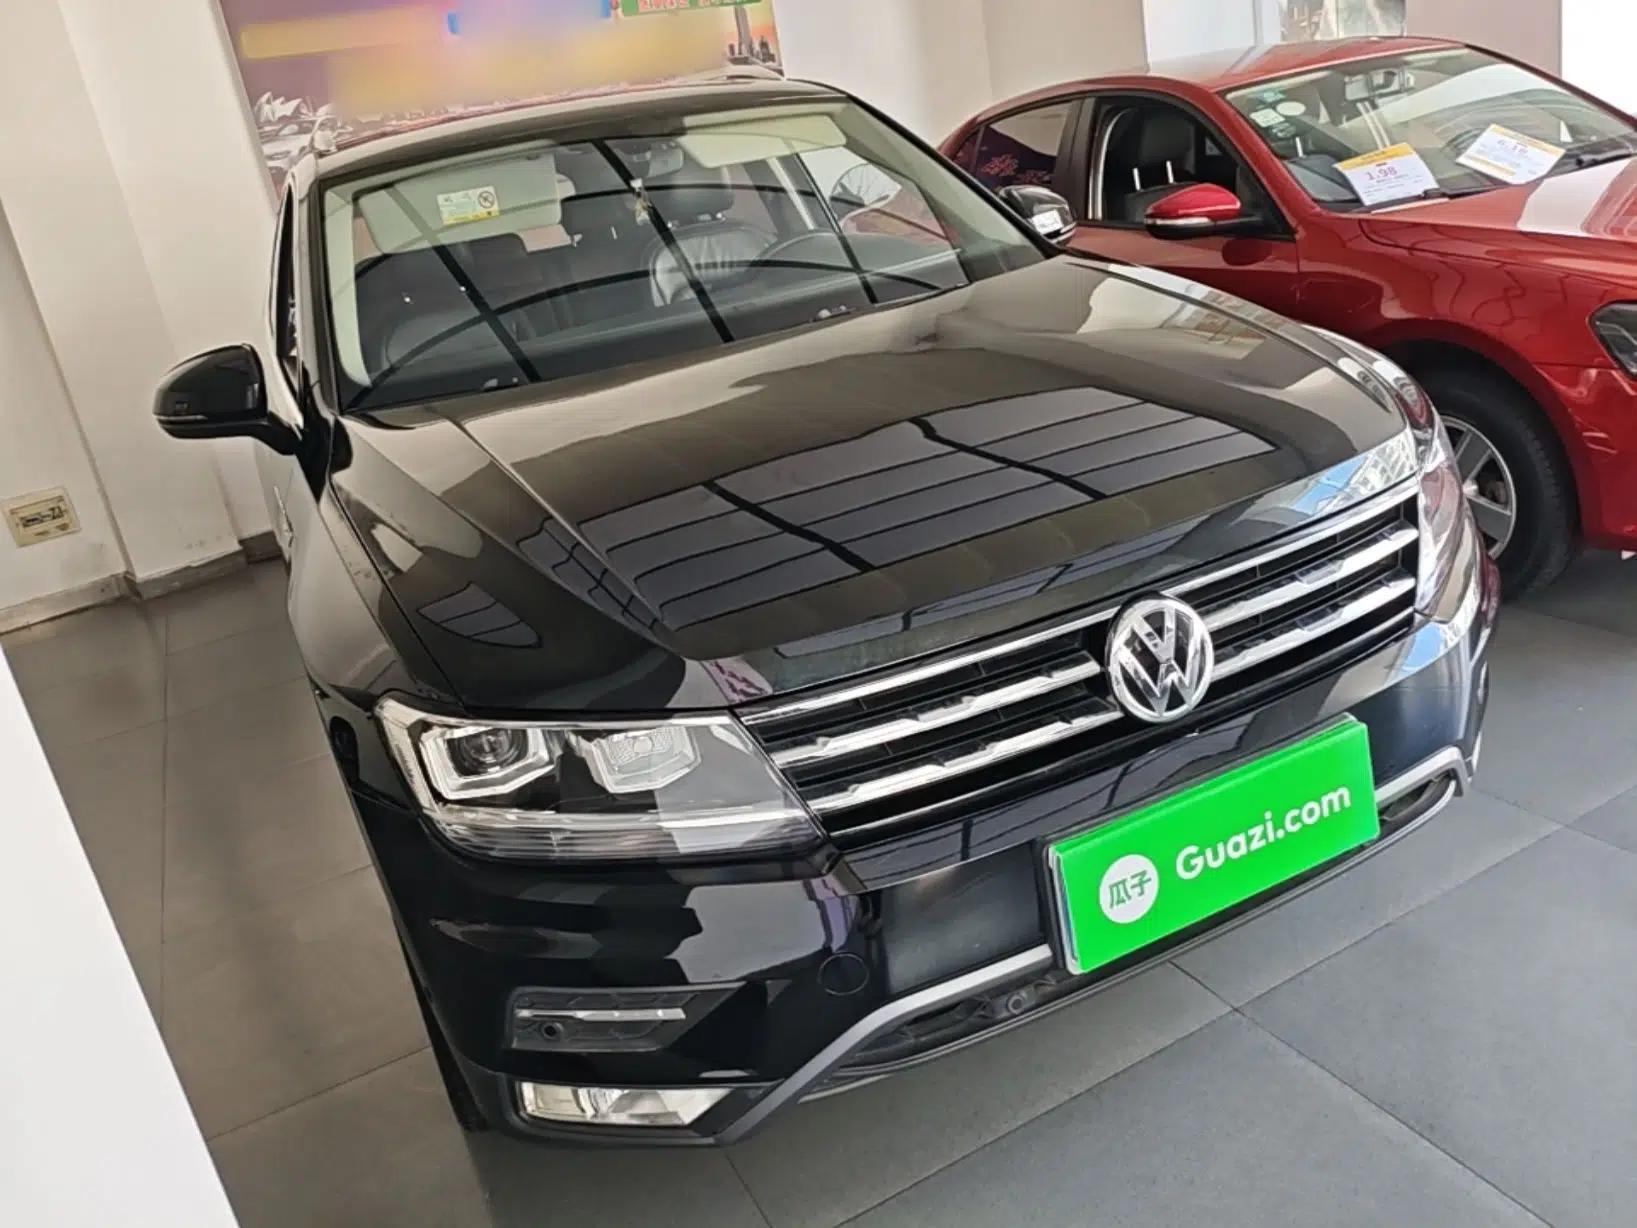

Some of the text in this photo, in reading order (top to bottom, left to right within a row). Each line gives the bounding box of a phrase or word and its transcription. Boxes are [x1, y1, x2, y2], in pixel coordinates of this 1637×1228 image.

[1366, 166, 1398, 181] 1.98
[1175, 786, 1351, 880] Guazi.com
[1108, 869, 1152, 909] 瓜子
